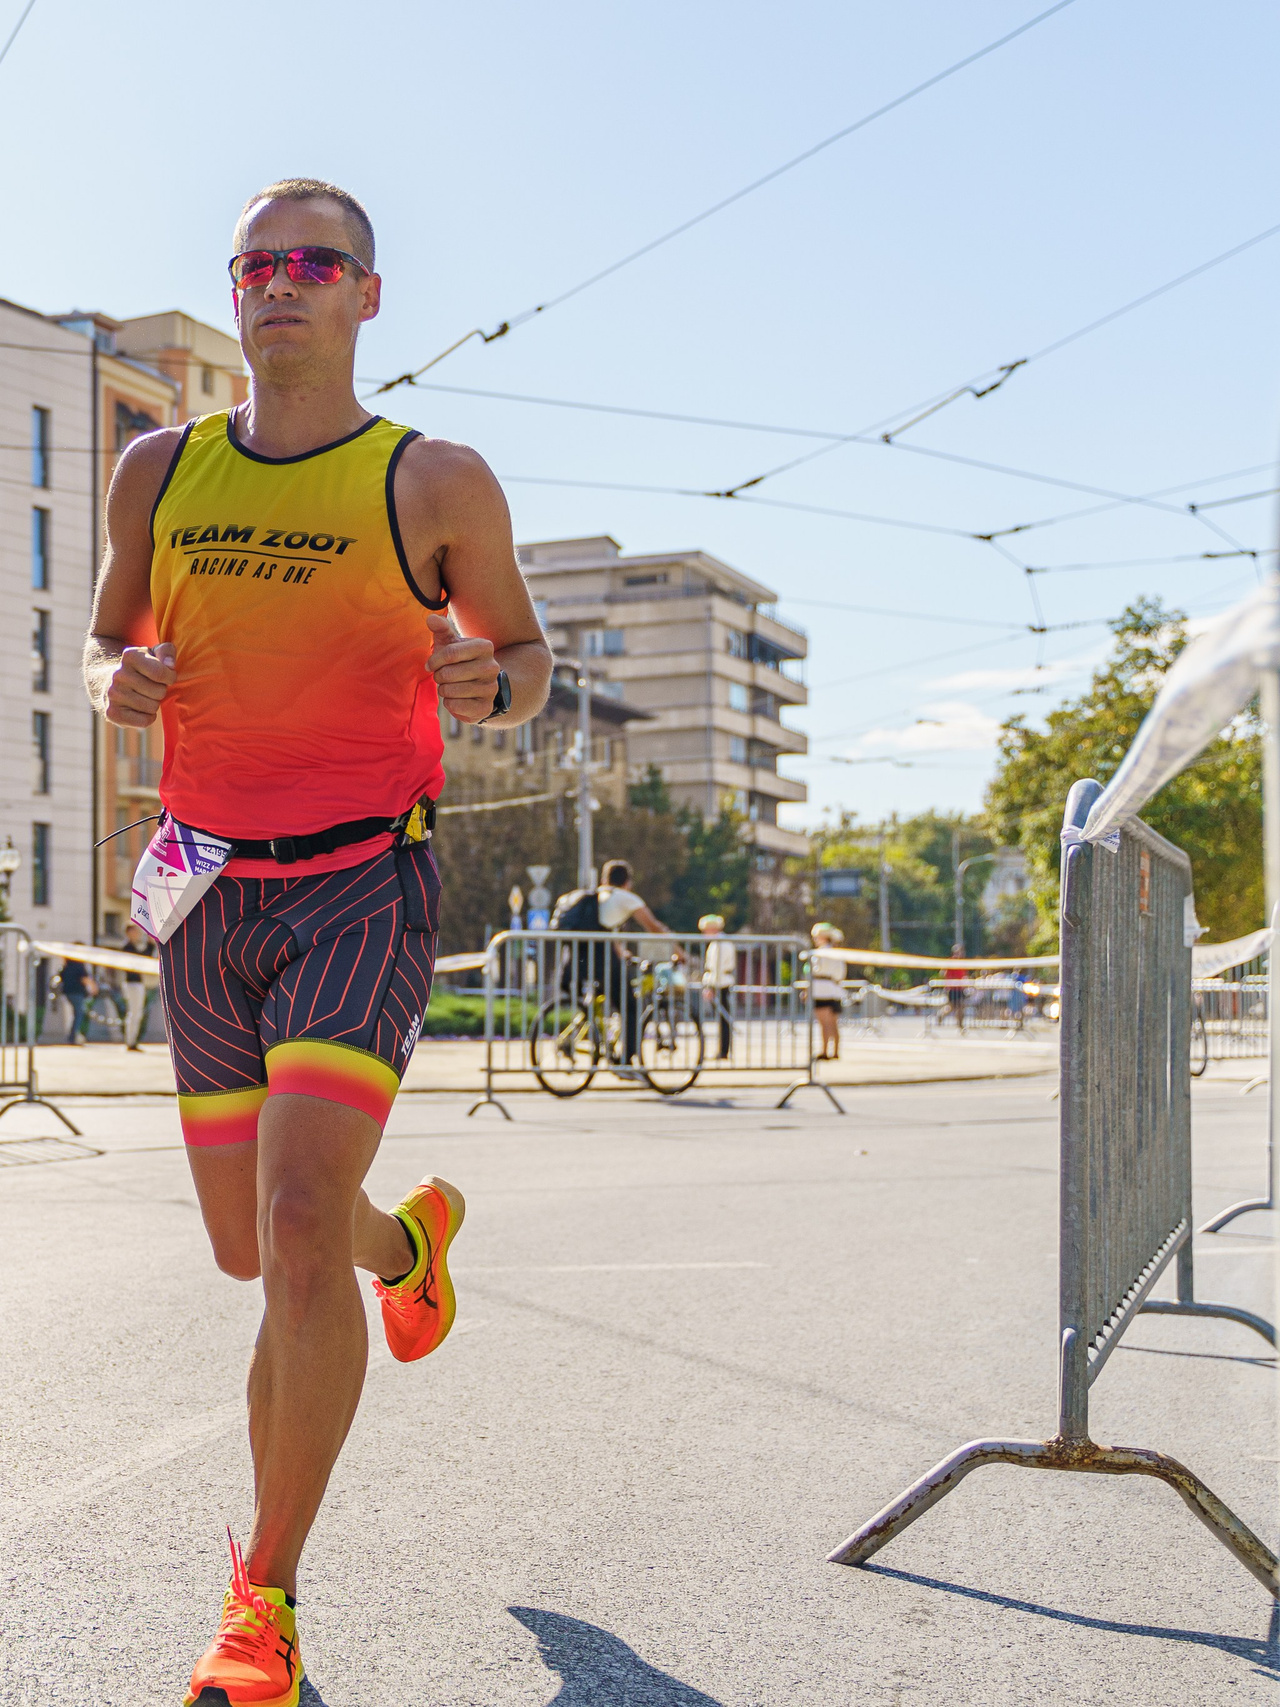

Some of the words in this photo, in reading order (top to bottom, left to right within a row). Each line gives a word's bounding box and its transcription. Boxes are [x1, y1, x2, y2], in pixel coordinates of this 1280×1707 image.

[169, 524, 257, 549] TEAM
[259, 529, 358, 555] ZOOT
[190, 557, 249, 576] RACING
[252, 561, 277, 580] AS
[282, 565, 317, 584] ONE
[195, 858, 211, 870] WIZZ
[401, 1013, 420, 1056] TEAM
